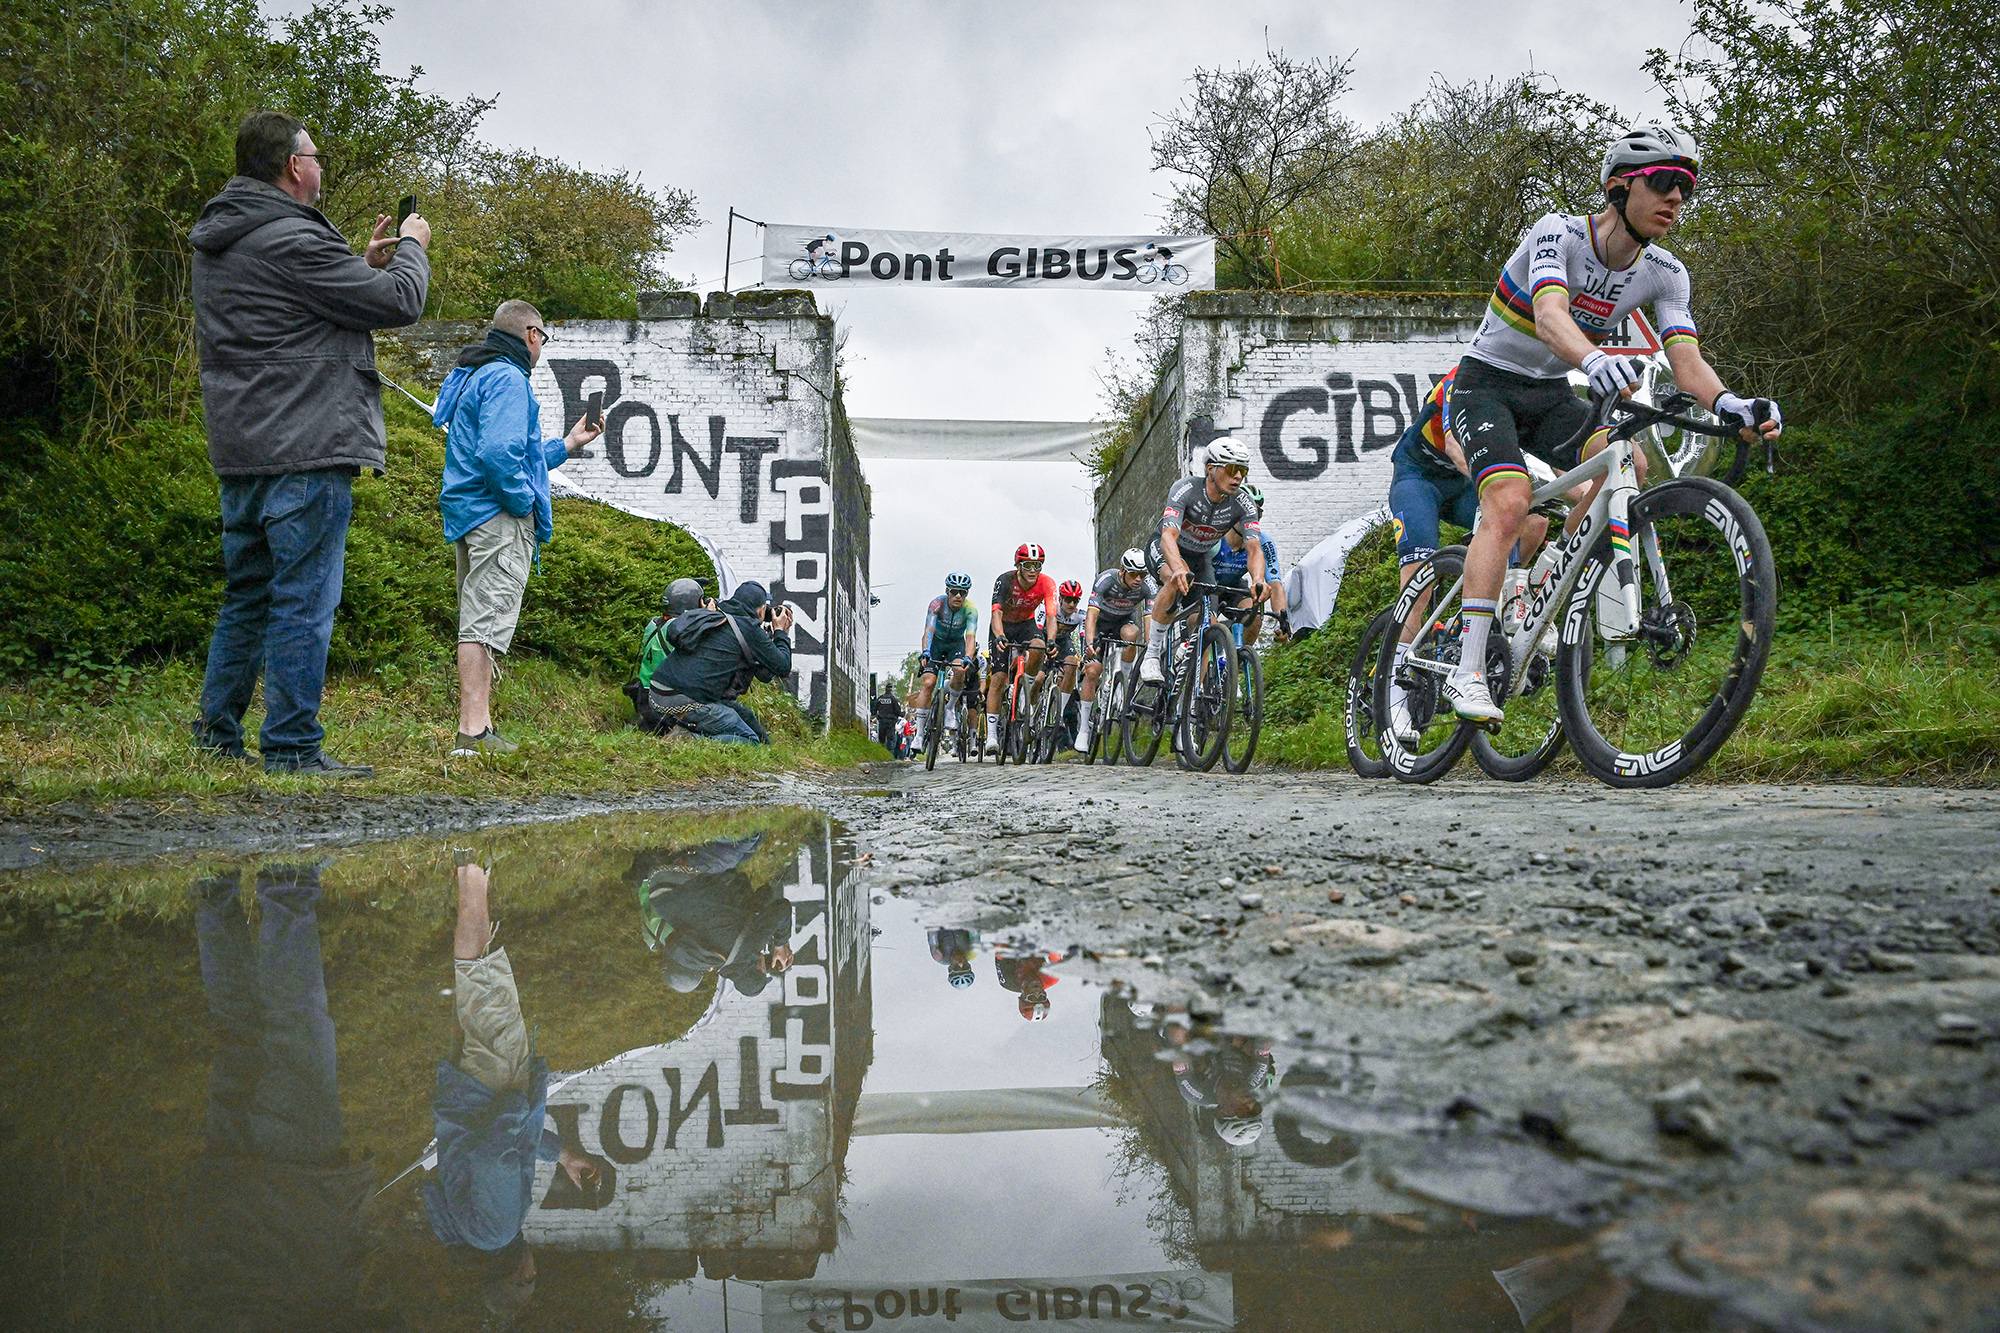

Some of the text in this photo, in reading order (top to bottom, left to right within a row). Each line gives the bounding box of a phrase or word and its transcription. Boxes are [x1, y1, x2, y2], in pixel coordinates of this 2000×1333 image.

[841, 241, 1138, 282] Pont GIBUS
[1651, 257, 1681, 274] Analog
[1576, 297, 1609, 314] Emirates
[1583, 274, 1624, 301] UAE
[547, 359, 779, 523] PONT
[1455, 408, 1472, 447] UAE
[775, 476, 830, 710] PONT
[1523, 514, 1592, 633] COLNAGO
[1346, 676, 1358, 749] AEOLUS
